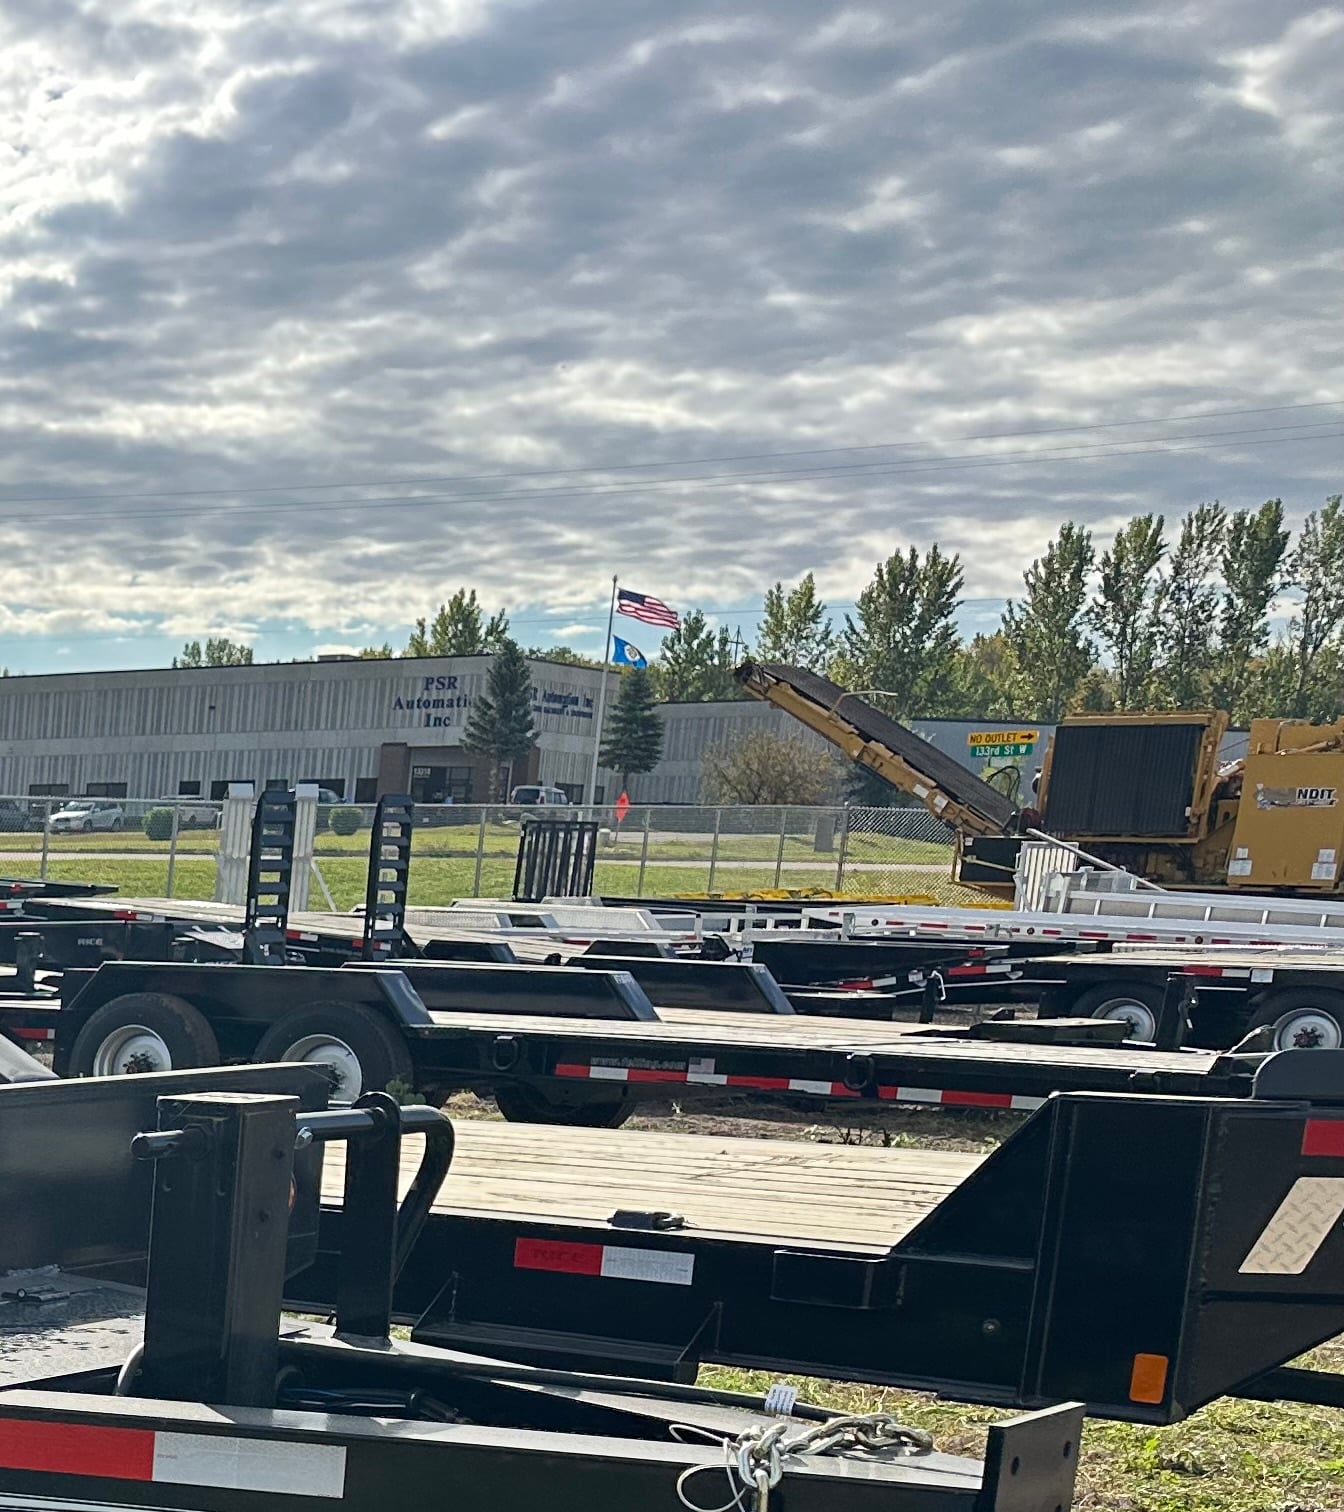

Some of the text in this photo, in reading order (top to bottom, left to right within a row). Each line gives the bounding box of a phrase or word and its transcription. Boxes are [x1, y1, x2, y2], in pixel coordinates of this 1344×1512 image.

[424, 675, 459, 691] PSR
[393, 694, 474, 711] Automati
[424, 713, 451, 727] Inc
[969, 732, 1018, 744] NO OUTLET
[976, 746, 1000, 756] 133rd
[1019, 744, 1027, 754] W
